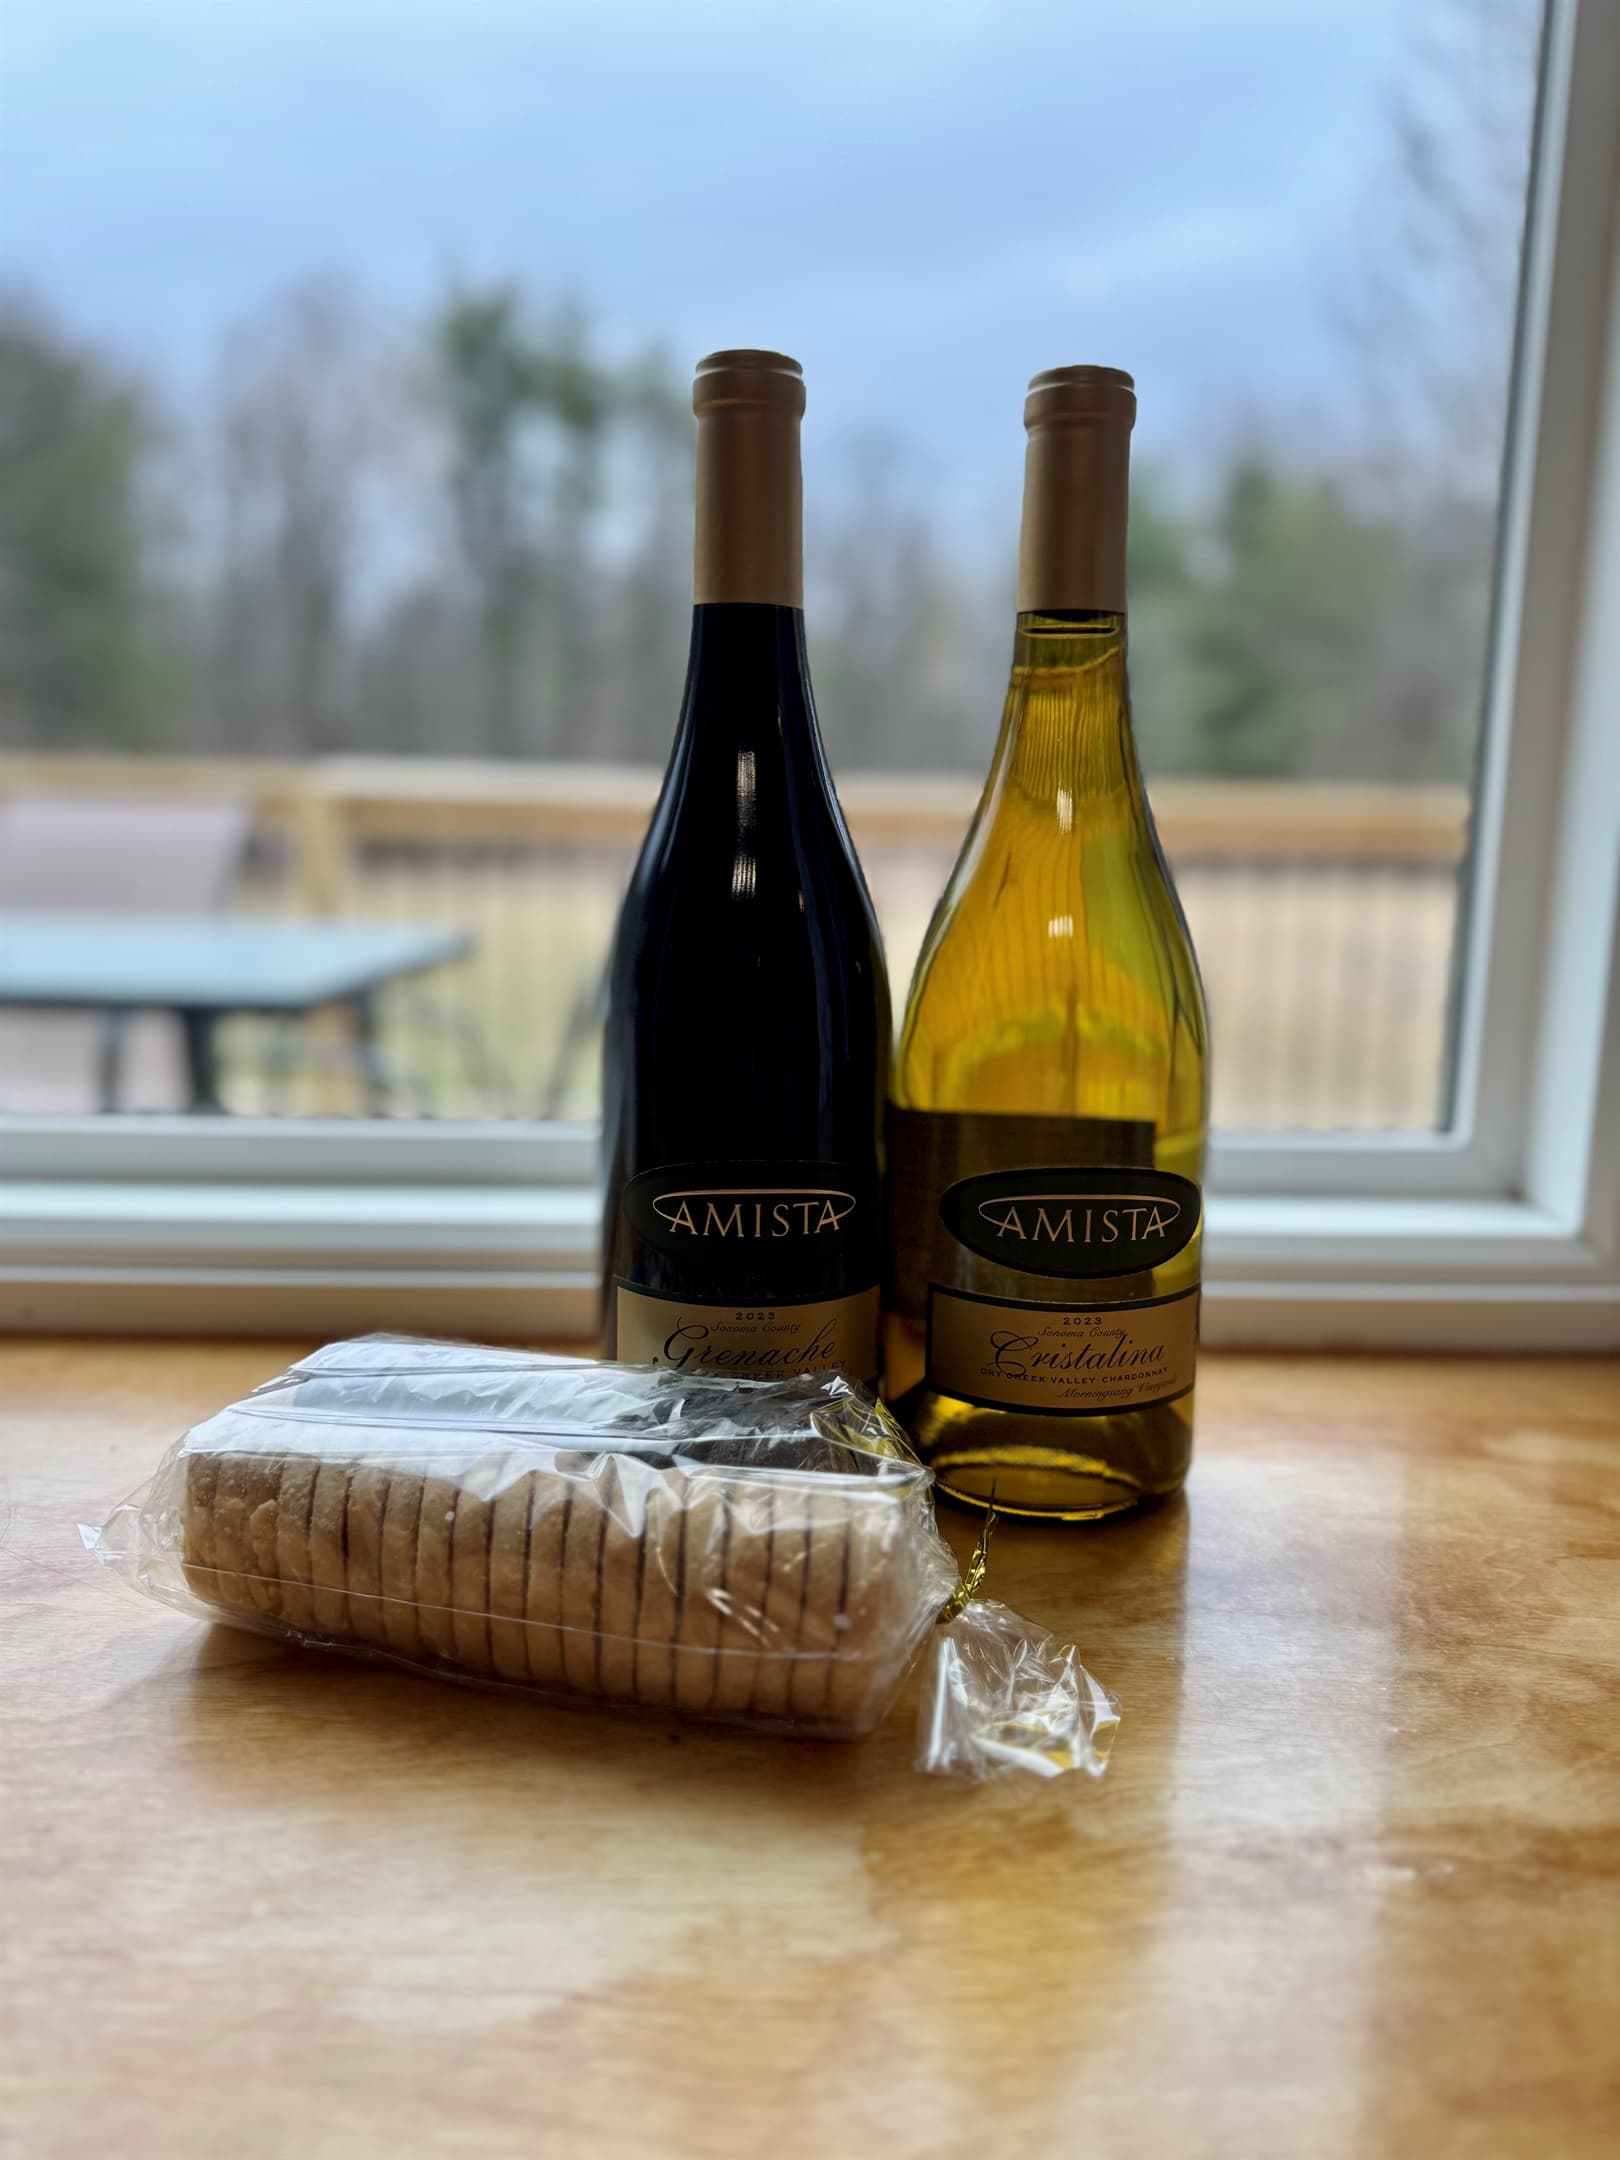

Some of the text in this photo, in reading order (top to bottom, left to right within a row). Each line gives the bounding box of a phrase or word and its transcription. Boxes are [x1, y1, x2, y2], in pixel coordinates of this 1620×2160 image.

[668, 1200, 841, 1238] AMISTA
[996, 1205, 1166, 1243] AMISTA
[735, 1311, 776, 1321] 2023
[1063, 1316, 1103, 1326] 2023
[710, 1321, 801, 1335] Sonoma County
[1037, 1326, 1127, 1339] Sonoma County
[653, 1316, 838, 1368] Grenache
[987, 1330, 1165, 1378] Cristalina
[980, 1366, 1169, 1385] DRY CREEK VALLEY CHARDONNAY
